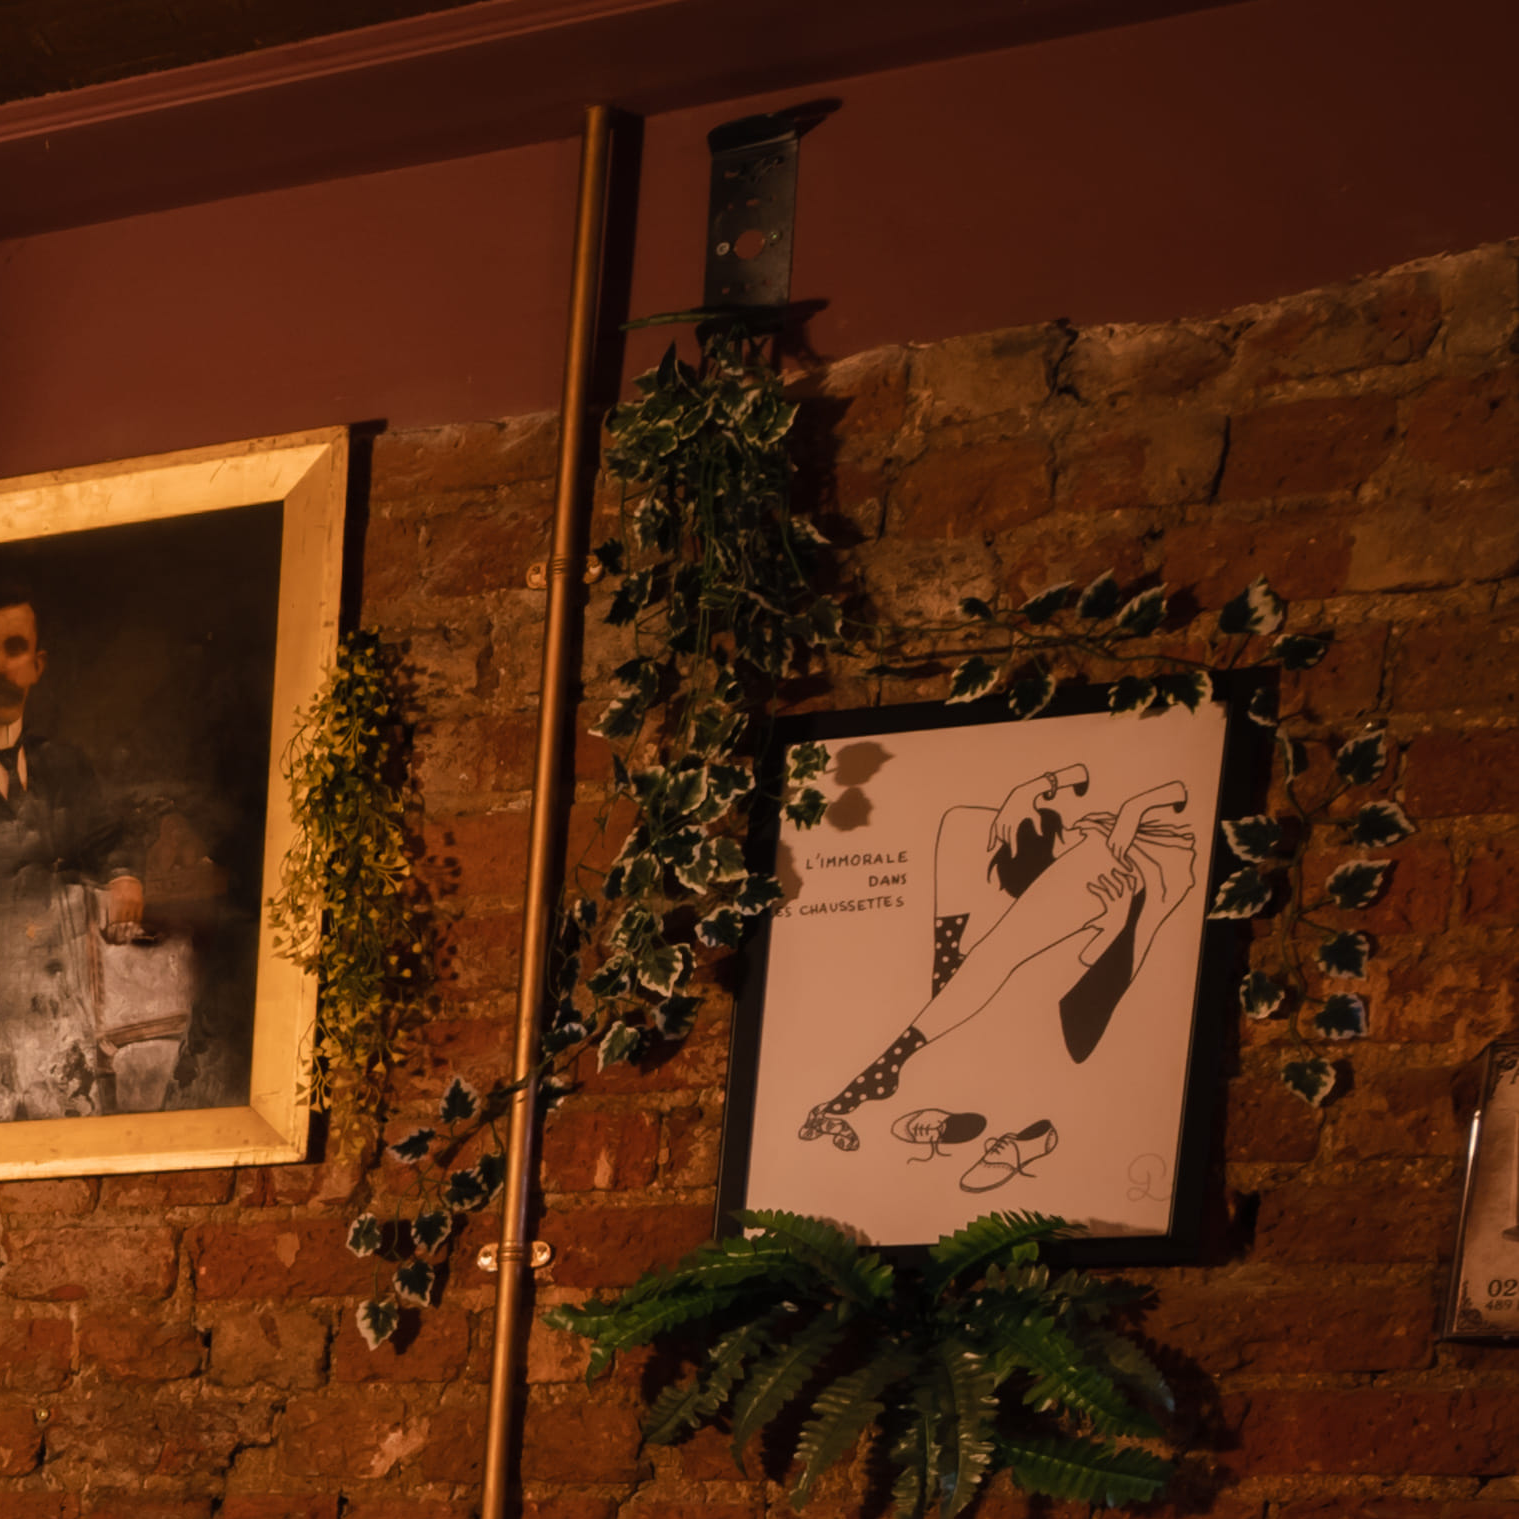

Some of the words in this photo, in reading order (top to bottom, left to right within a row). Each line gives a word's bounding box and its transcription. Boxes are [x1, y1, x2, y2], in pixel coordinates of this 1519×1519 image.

[805, 850, 909, 870] L'IMMORALE
[868, 873, 908, 888] DANS
[799, 896, 905, 916] CHAUSSETTES
